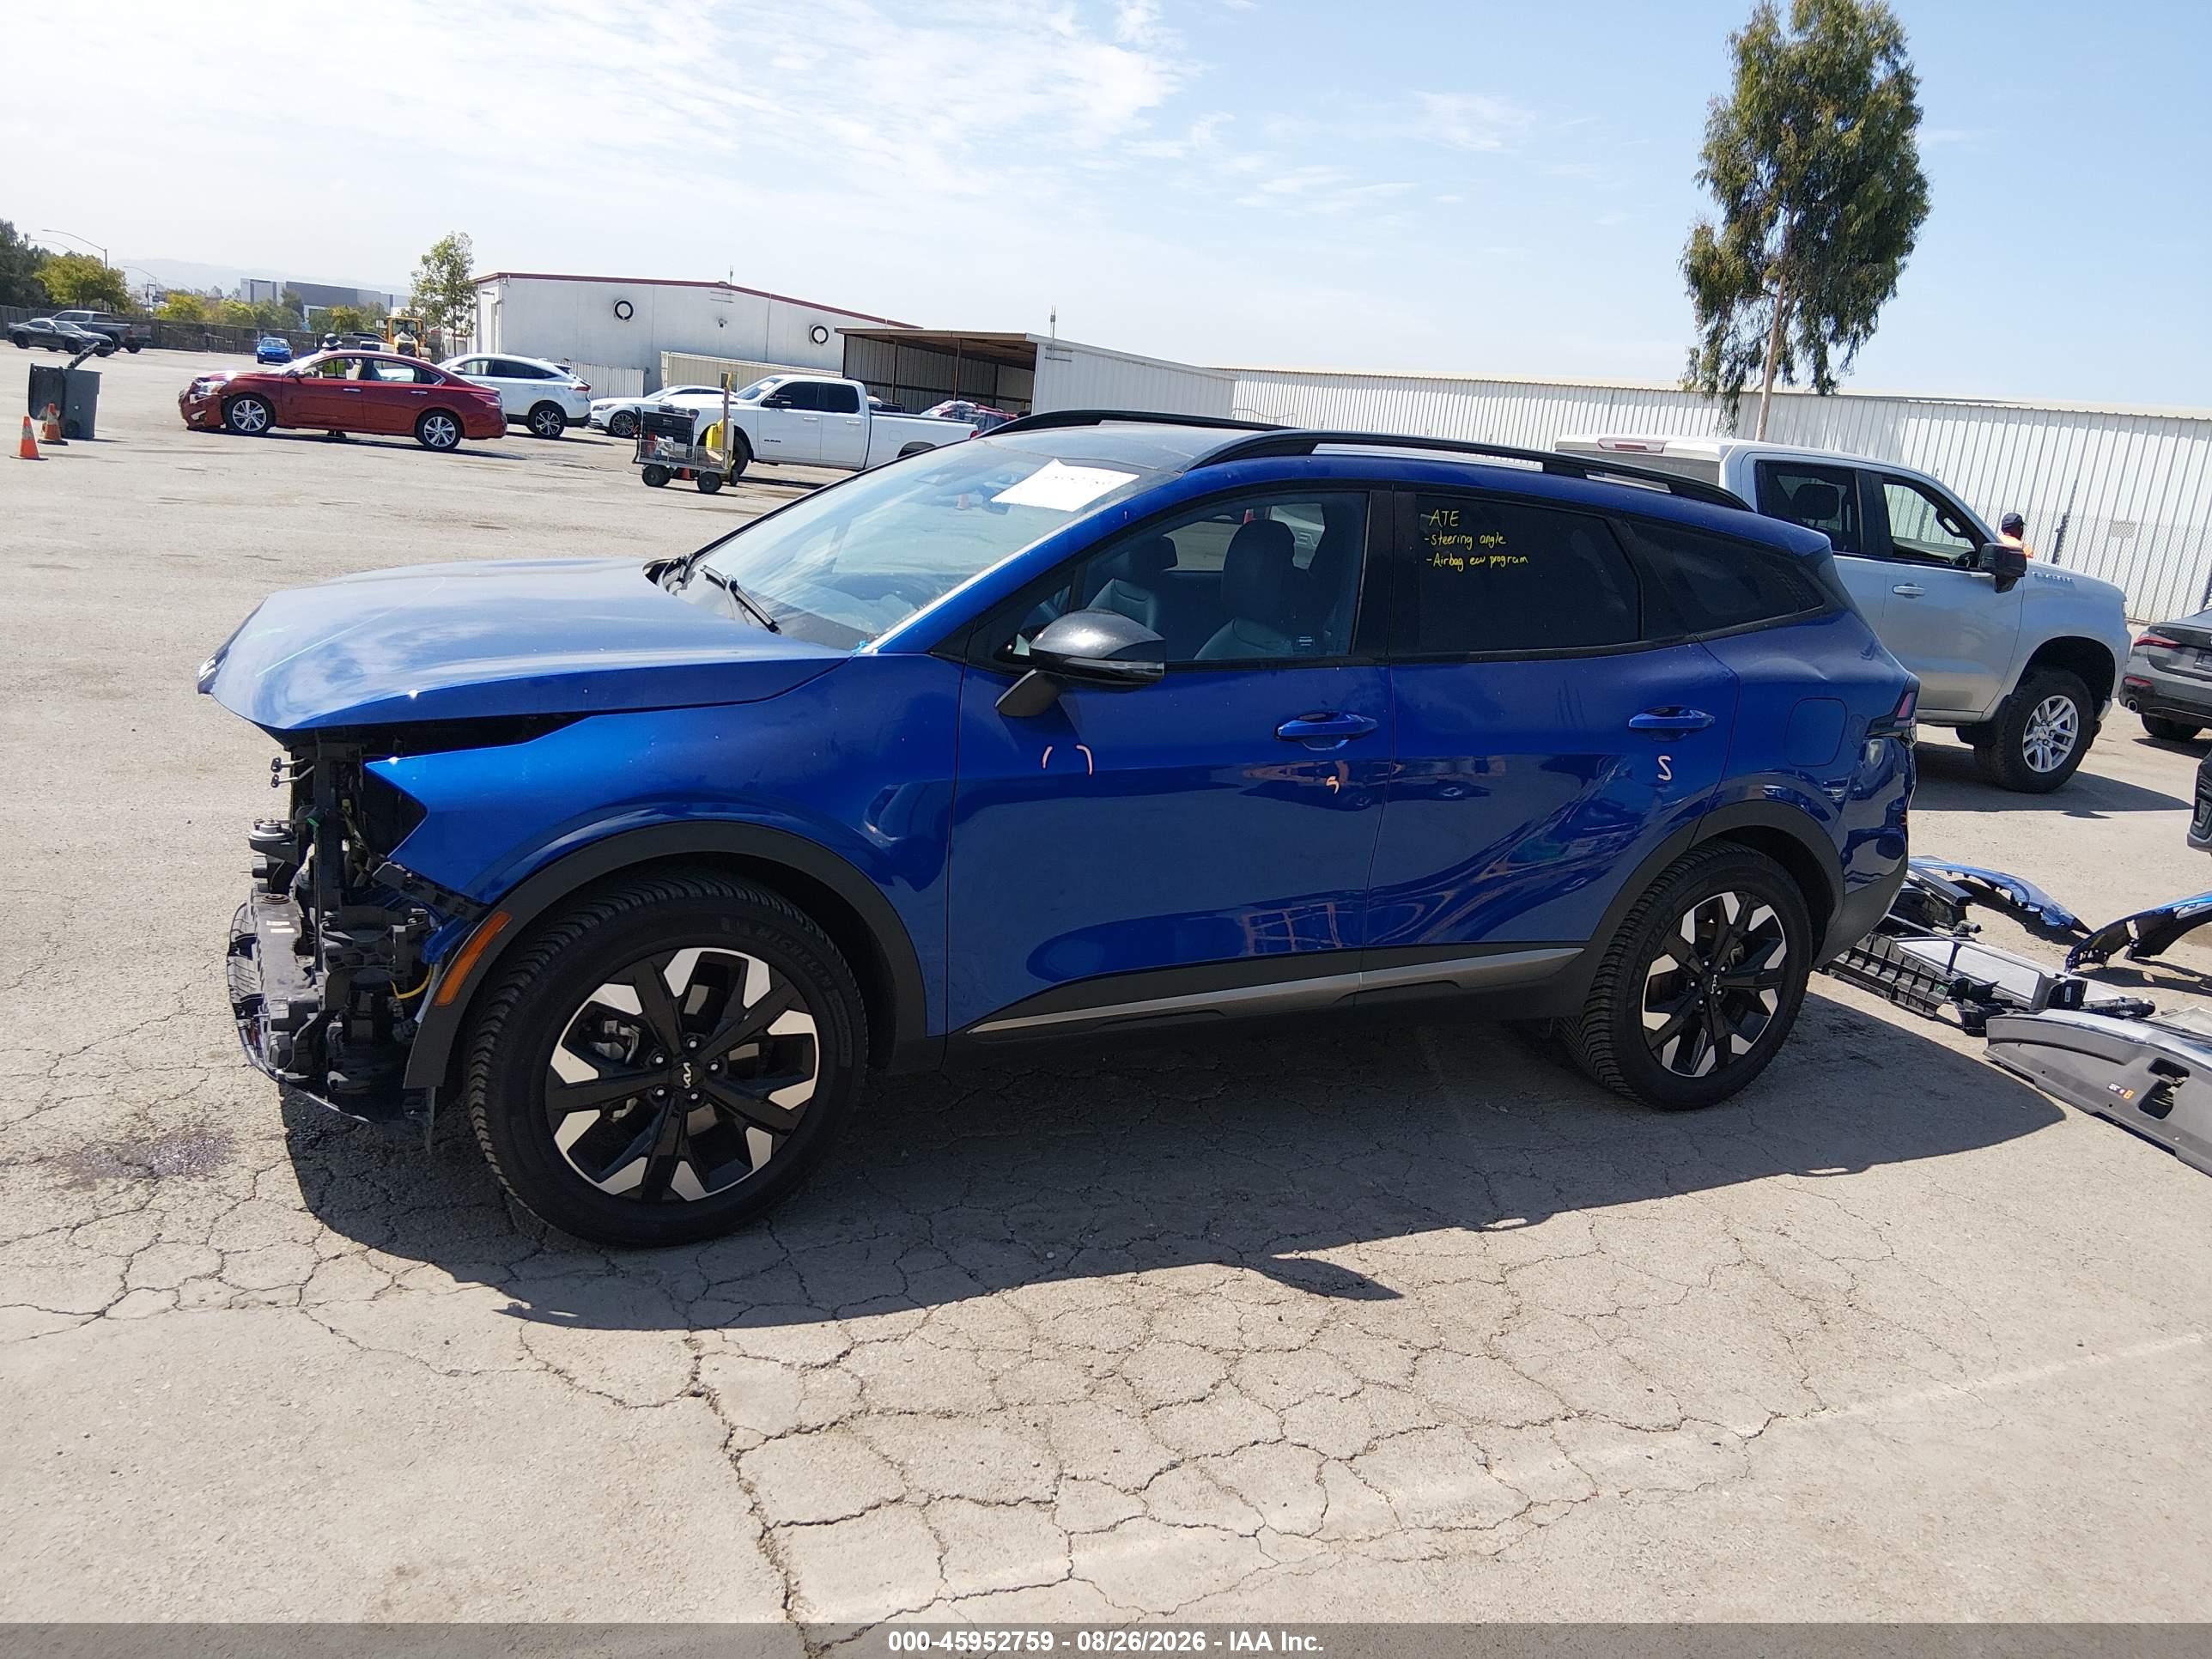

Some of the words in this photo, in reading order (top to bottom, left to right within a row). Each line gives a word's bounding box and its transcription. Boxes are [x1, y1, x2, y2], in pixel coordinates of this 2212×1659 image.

[1429, 508, 1460, 528] ATE
[1480, 532, 1507, 549] angle
[1489, 555, 1529, 569] program
